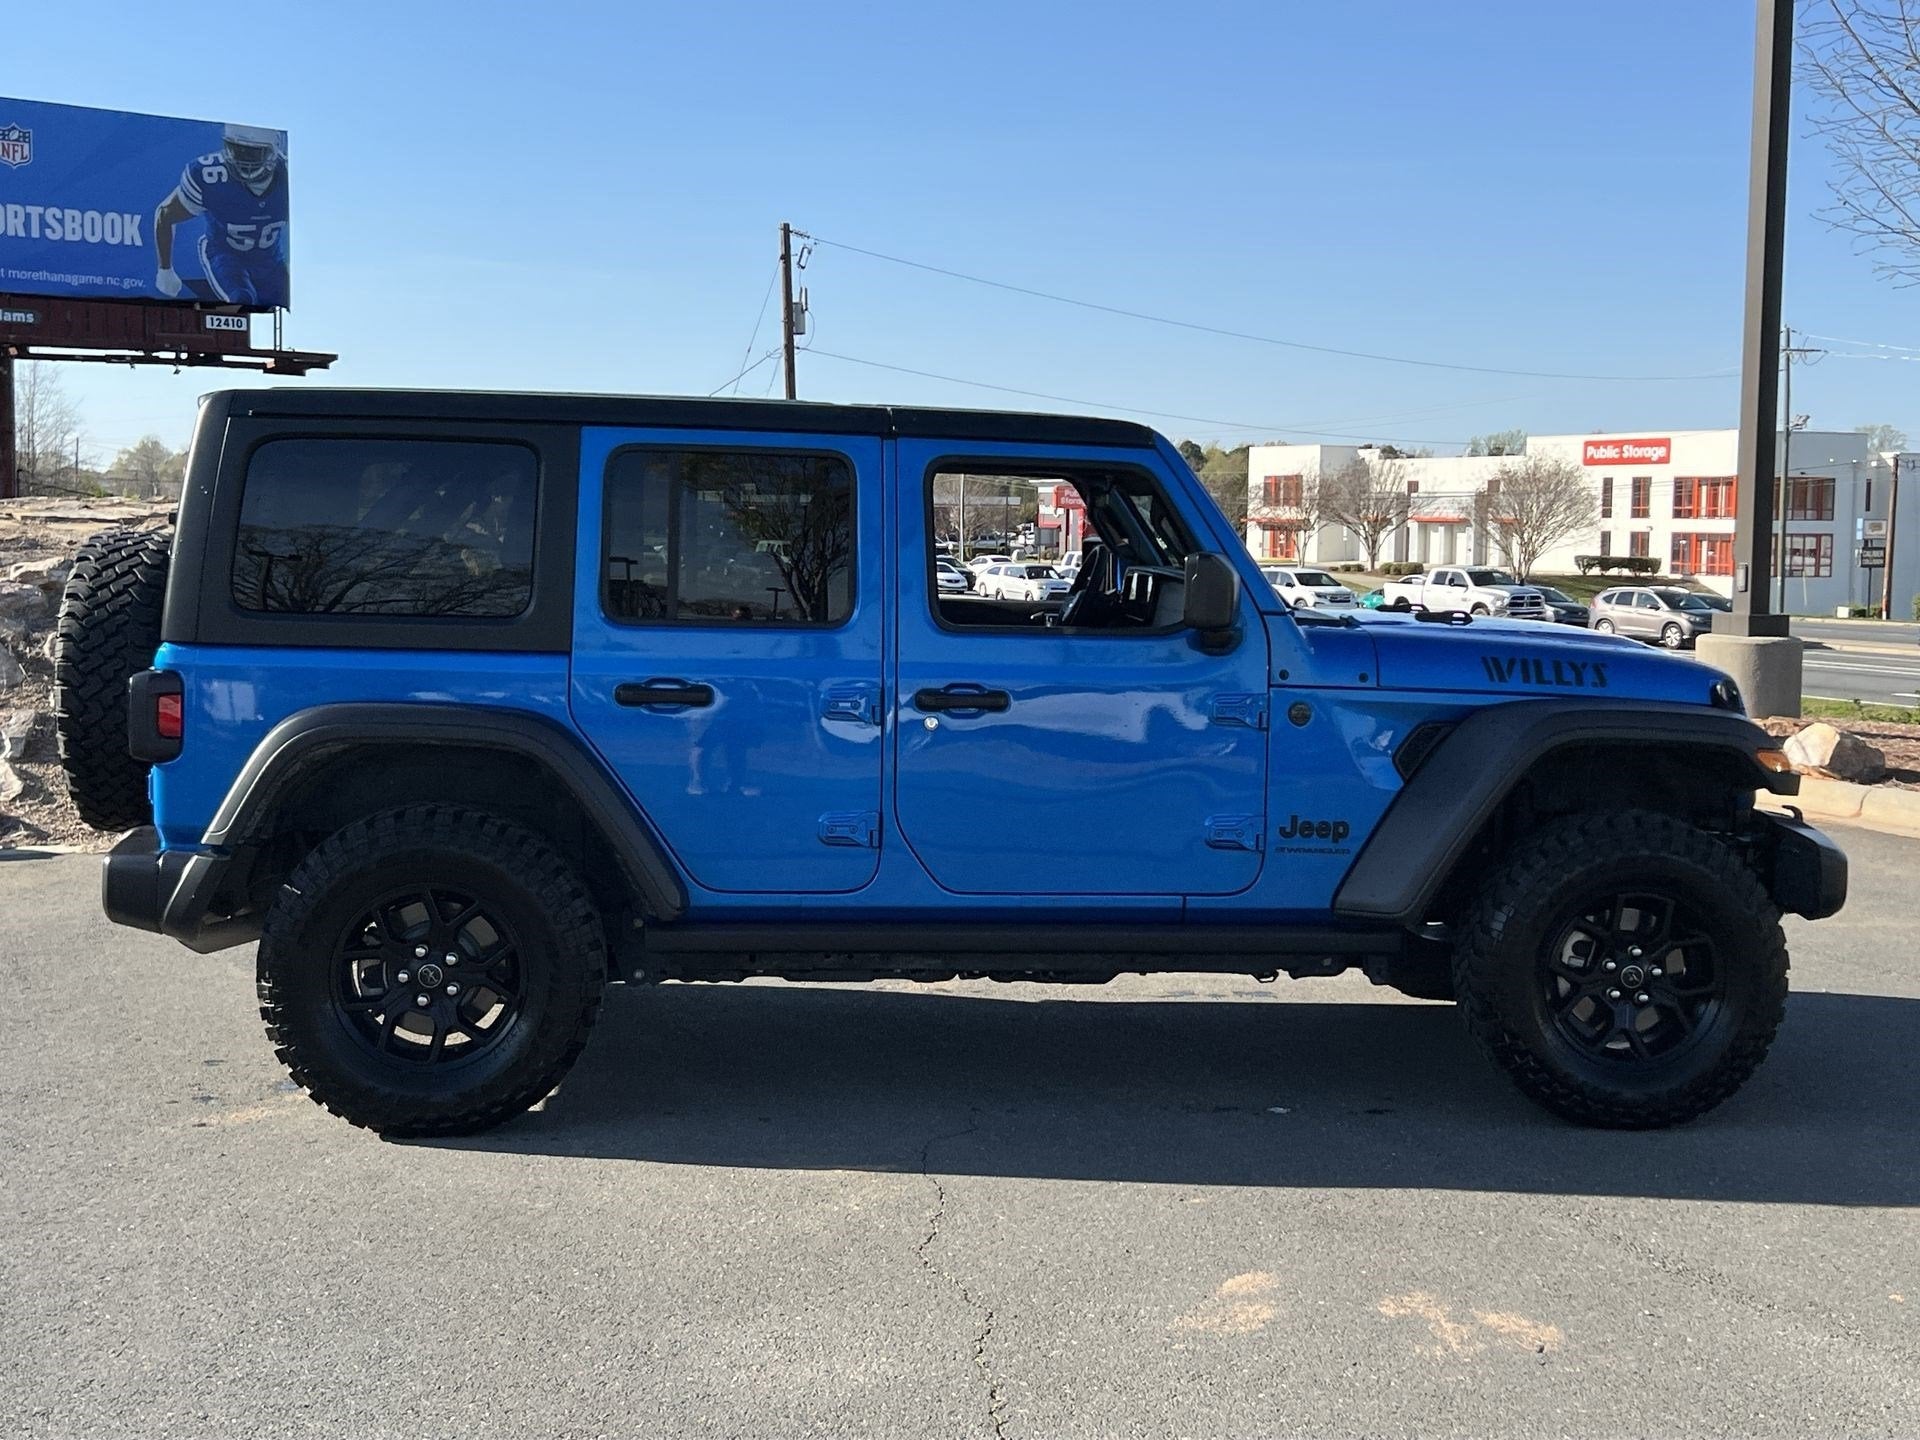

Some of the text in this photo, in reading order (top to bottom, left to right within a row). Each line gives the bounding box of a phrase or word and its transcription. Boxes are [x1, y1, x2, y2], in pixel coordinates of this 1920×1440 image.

[2, 142, 28, 161] NFL
[0, 203, 143, 246] RTSBOOK
[8, 269, 146, 289] morethanagame.nc.gov.
[210, 316, 243, 328] 12410
[1586, 444, 1667, 461] Public Storage
[1481, 655, 1608, 688] WILLYS
[1279, 815, 1350, 843] Jeep
